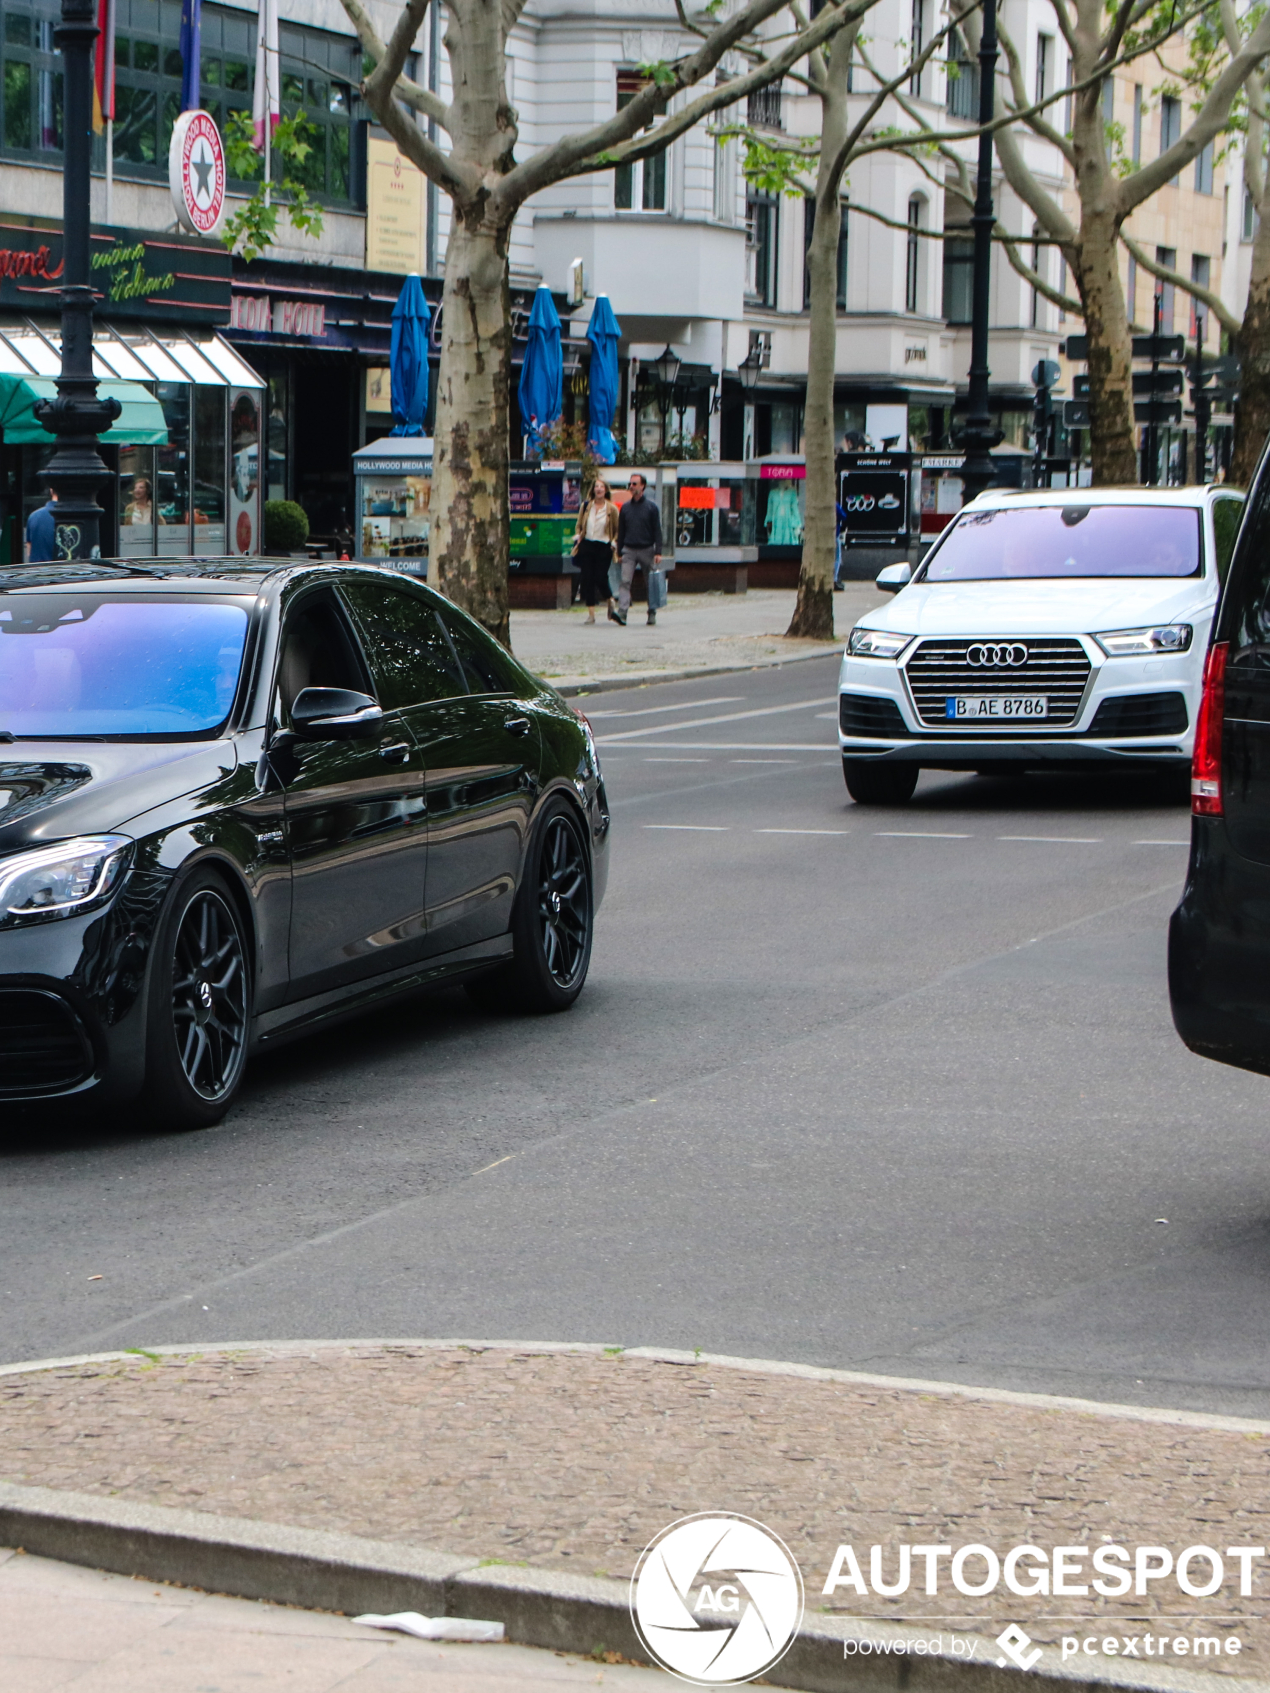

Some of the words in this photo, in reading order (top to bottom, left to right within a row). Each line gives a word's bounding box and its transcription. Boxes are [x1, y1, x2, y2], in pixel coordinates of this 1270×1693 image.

[183, 120, 200, 208] HOLLYWOOD
[200, 118, 220, 157] MEDIA
[214, 161, 223, 210] HOTEL
[192, 207, 215, 228] BERLIN
[283, 301, 327, 337] HOTEL
[357, 461, 400, 470] HOLLYWOOD
[401, 462, 423, 470] MEDIA
[380, 561, 421, 571] WELCOME
[957, 700, 966, 714] B
[978, 700, 998, 714] AE
[1003, 700, 1044, 715] 8786
